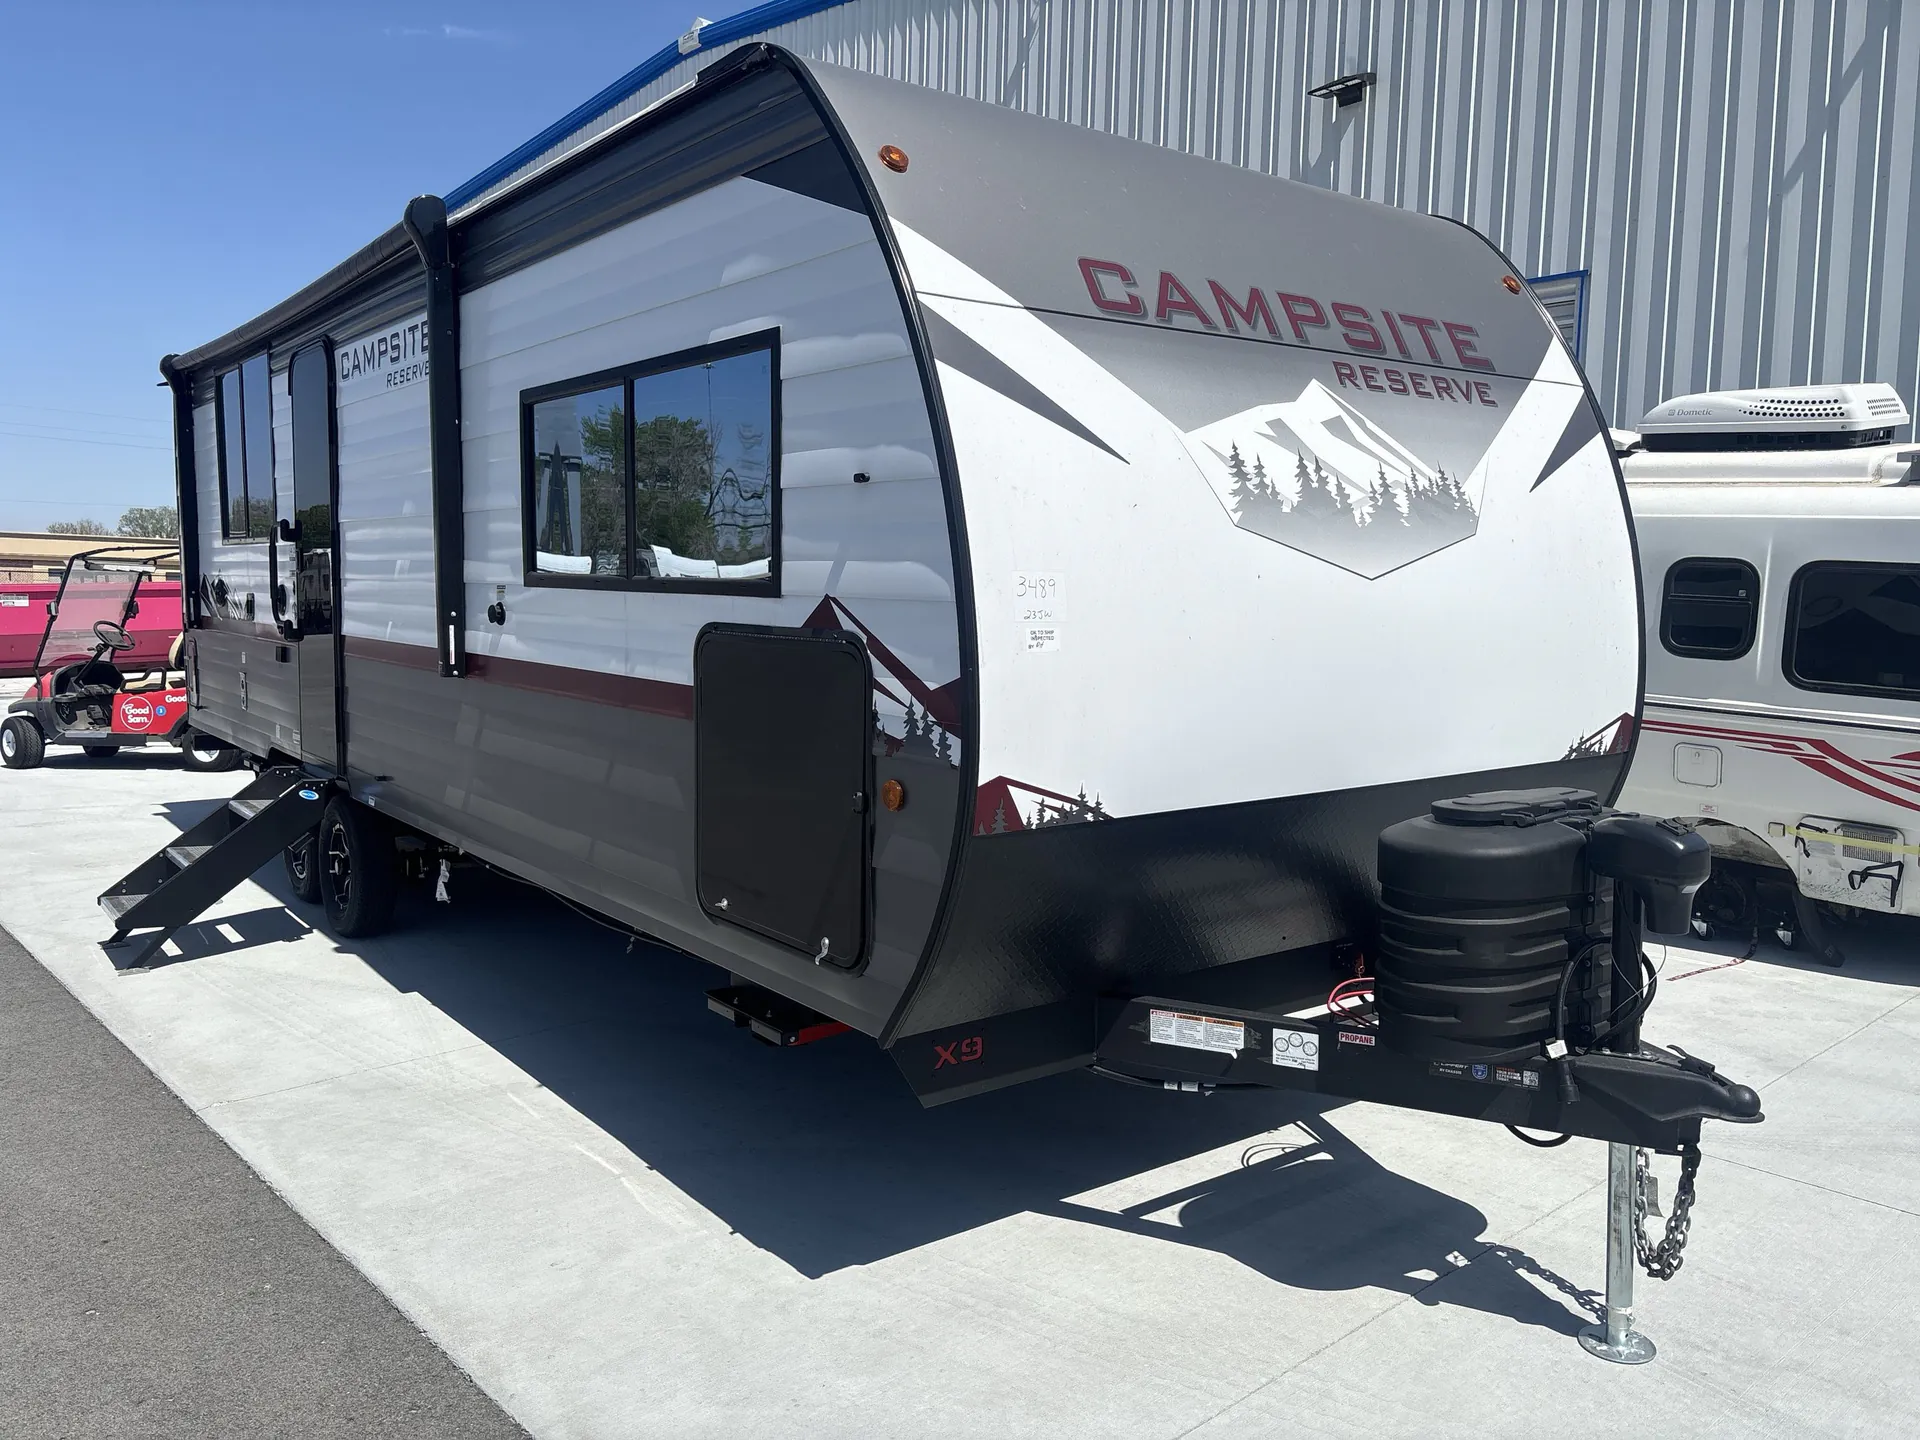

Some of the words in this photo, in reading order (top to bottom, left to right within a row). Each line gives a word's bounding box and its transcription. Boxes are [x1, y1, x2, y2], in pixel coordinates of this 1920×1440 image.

[1077, 256, 1497, 373] CAMPSITE
[341, 320, 428, 382] CAMPSITE
[386, 360, 429, 389] RESERVE
[1332, 360, 1499, 408] RESERVE
[1676, 408, 1713, 416] Dometic
[1017, 575, 1056, 599] 3489
[125, 706, 150, 715] Good
[165, 694, 187, 703] Good
[1340, 1032, 1374, 1045] PROPANE
[934, 1036, 983, 1070] X9
